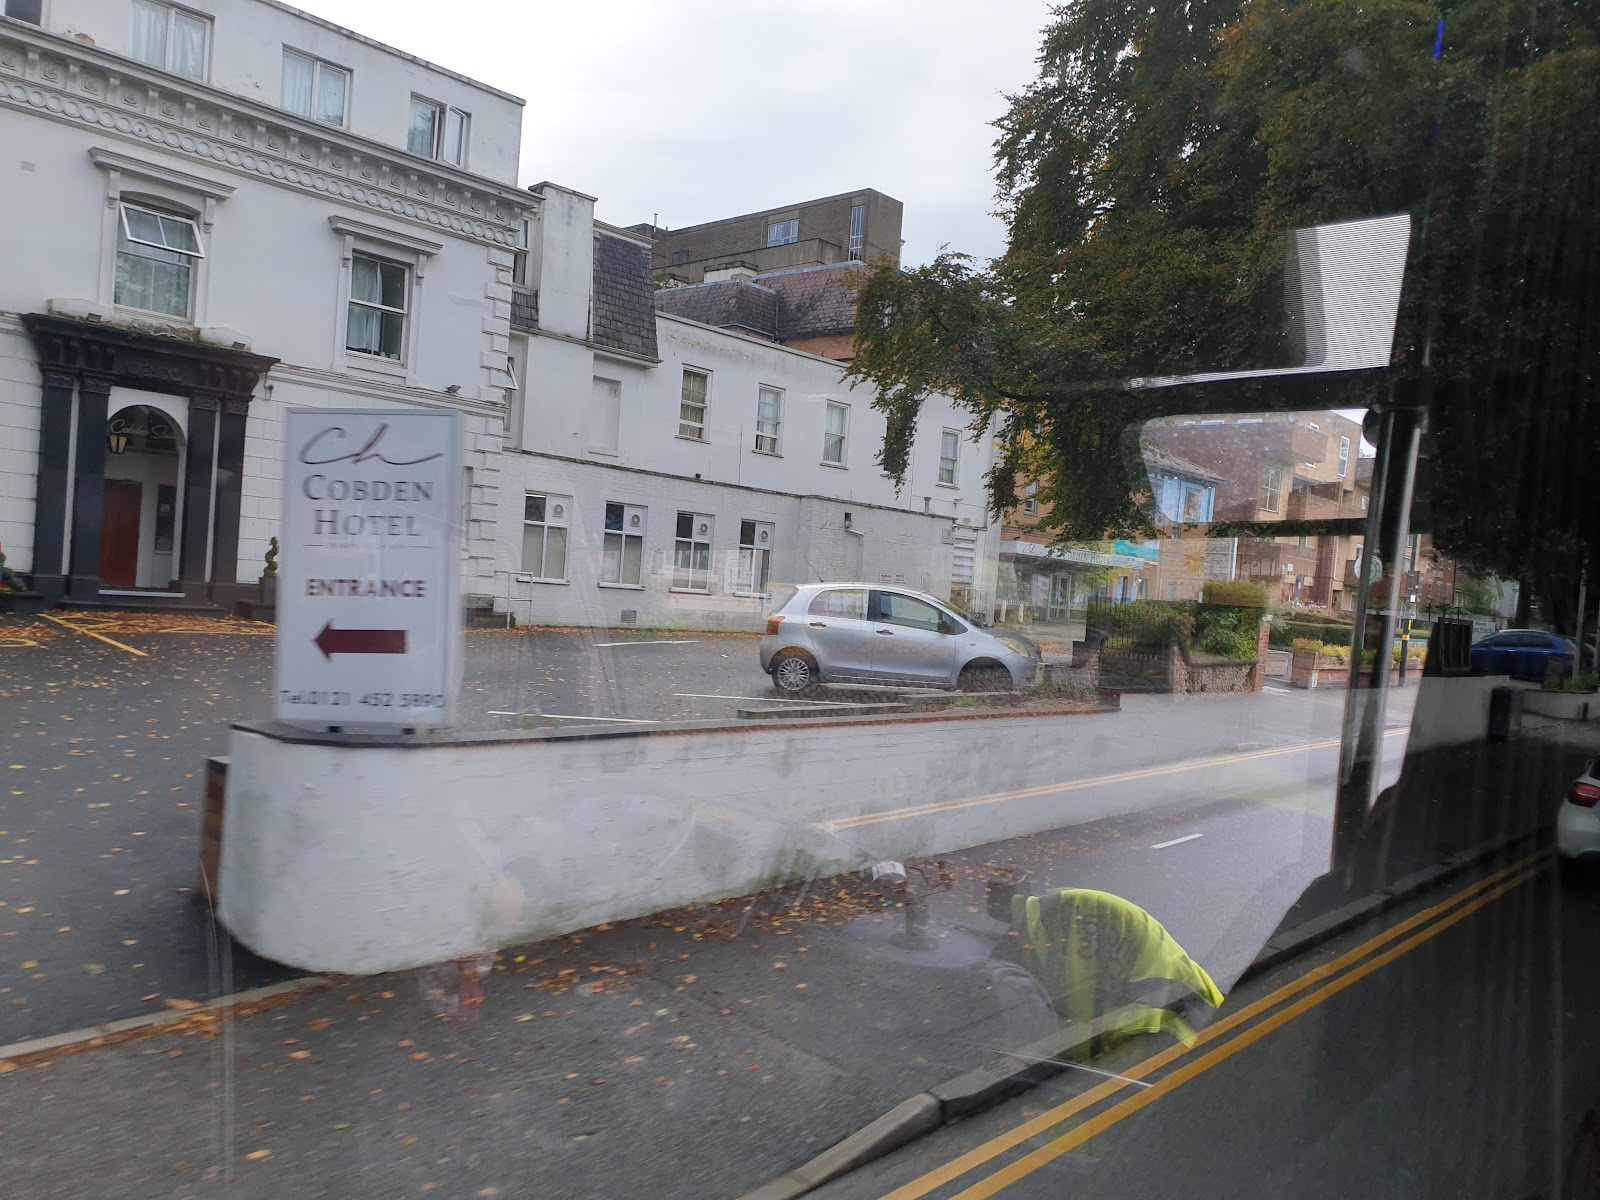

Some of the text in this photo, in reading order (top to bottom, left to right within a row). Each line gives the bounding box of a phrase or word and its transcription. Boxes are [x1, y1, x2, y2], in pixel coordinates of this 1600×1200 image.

[302, 474, 434, 502] COBDEN
[312, 509, 422, 537] HOTEL
[305, 578, 426, 598] ENTRANCE
